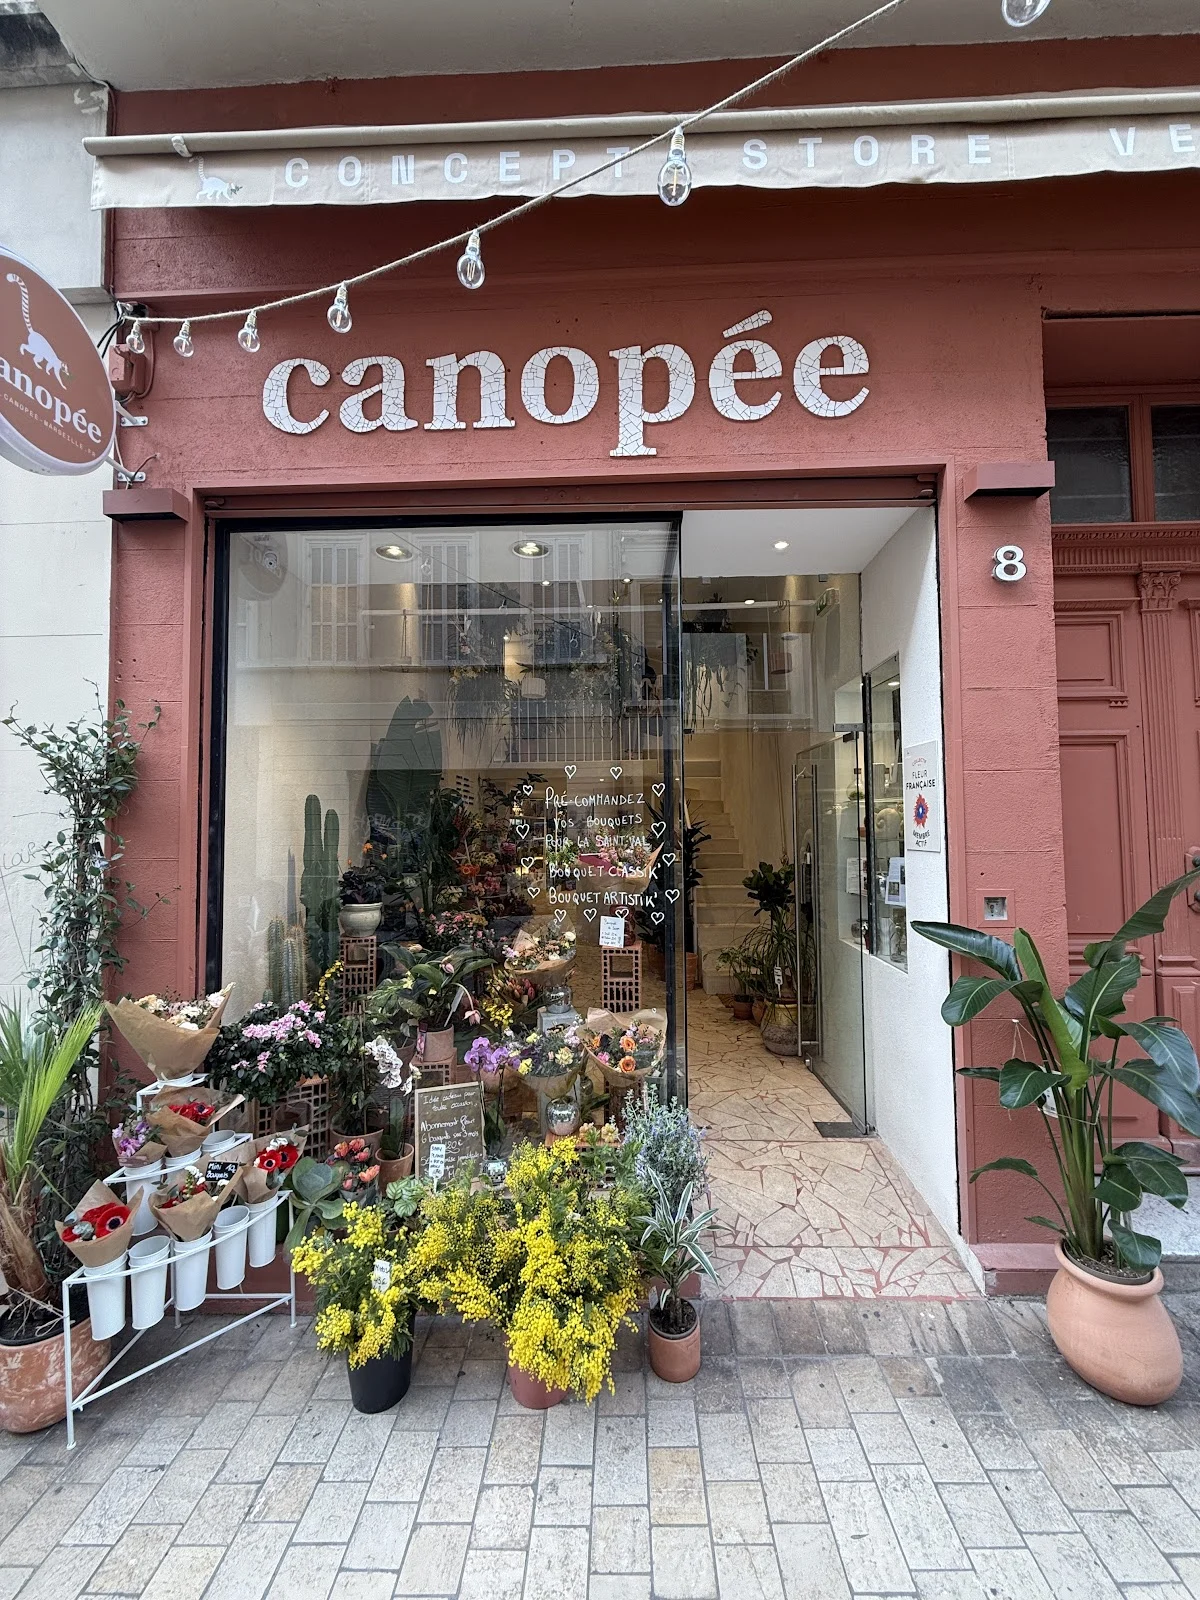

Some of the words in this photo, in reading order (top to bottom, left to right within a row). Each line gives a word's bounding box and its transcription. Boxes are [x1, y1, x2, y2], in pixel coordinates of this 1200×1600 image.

[285, 145, 631, 188] CONCEPT
[742, 134, 992, 170] STORE
[1108, 123, 1196, 156] VE
[261, 309, 870, 457] canopée
[993, 545, 1027, 582] 8
[912, 770, 928, 779] FLEUR
[906, 779, 936, 790] FRANÇAISE
[586, 813, 643, 830] BOUQUETS
[545, 833, 570, 849] POUR
[577, 836, 589, 848] LA
[913, 830, 930, 840] MEMBRE
[549, 862, 605, 881] BOUQUET
[549, 886, 601, 906] BOUQUET
[421, 1117, 458, 1132] Abonnement
[422, 1132, 427, 1143] 6
[462, 1129, 467, 1137] 3
